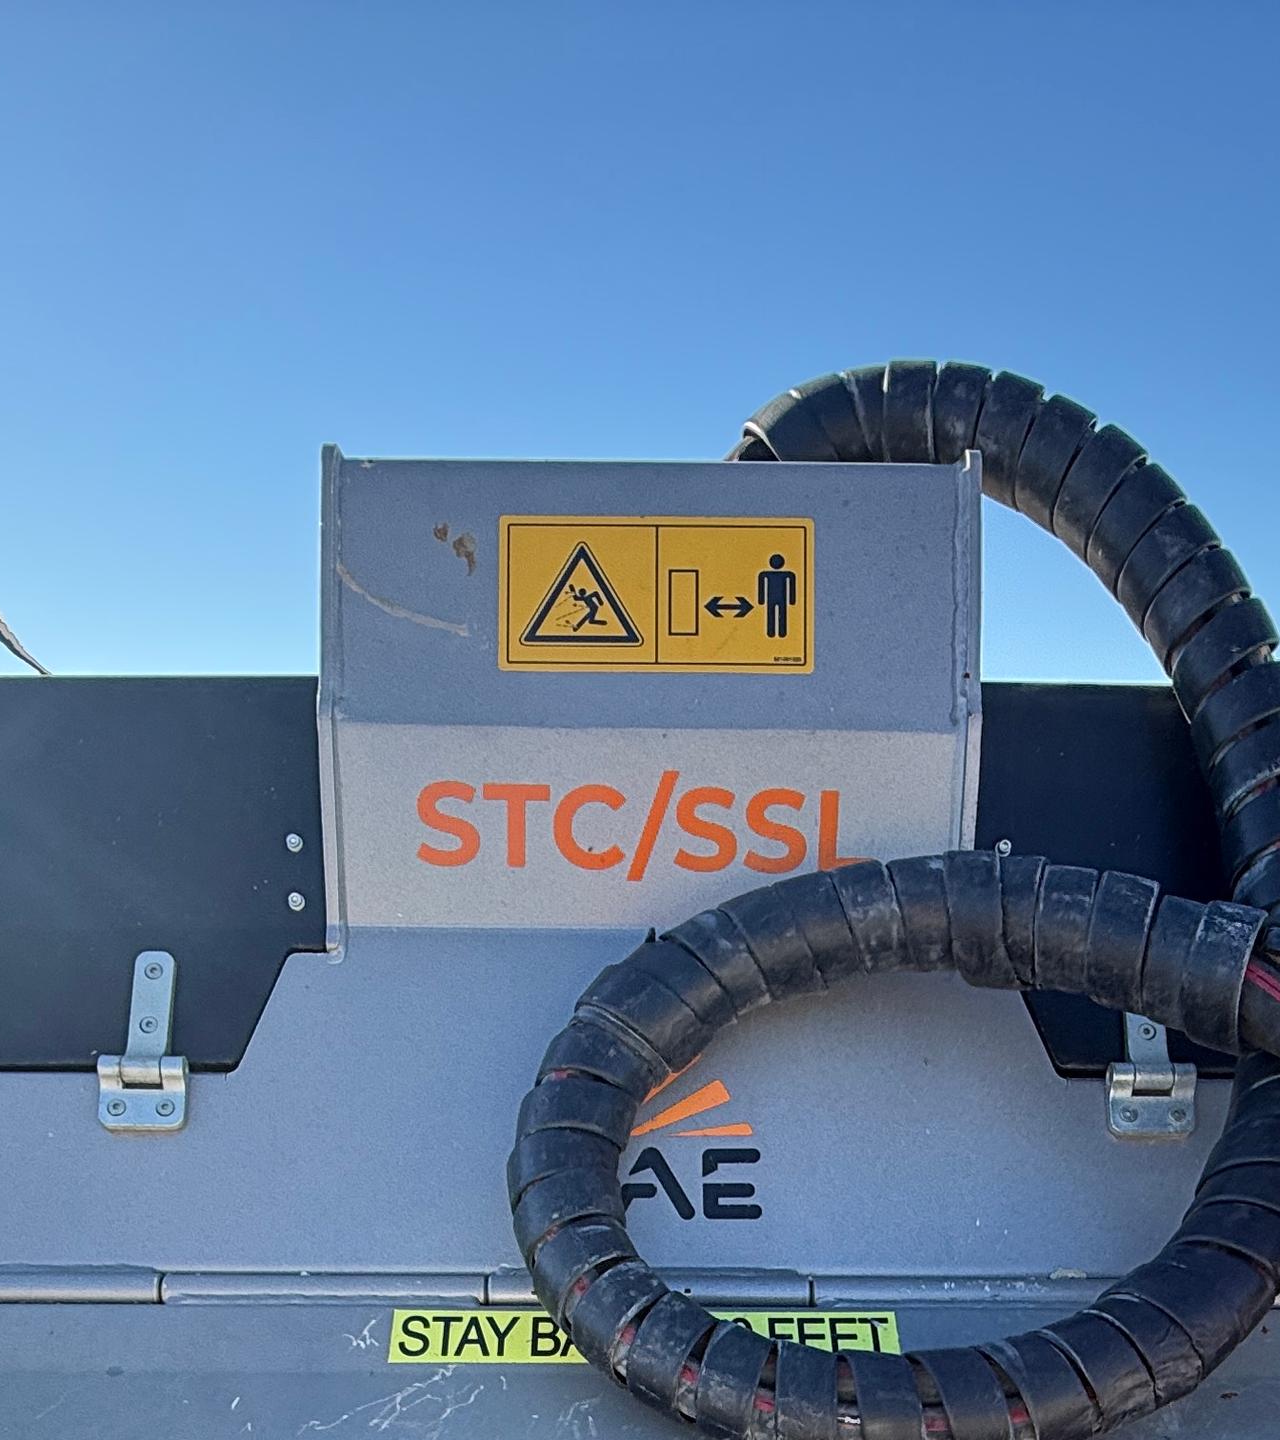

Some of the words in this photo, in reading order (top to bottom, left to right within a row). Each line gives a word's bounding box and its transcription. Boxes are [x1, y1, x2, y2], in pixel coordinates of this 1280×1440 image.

[415, 769, 879, 881] STC/SSL
[621, 1147, 763, 1220] AE
[398, 1315, 520, 1357] STAY
